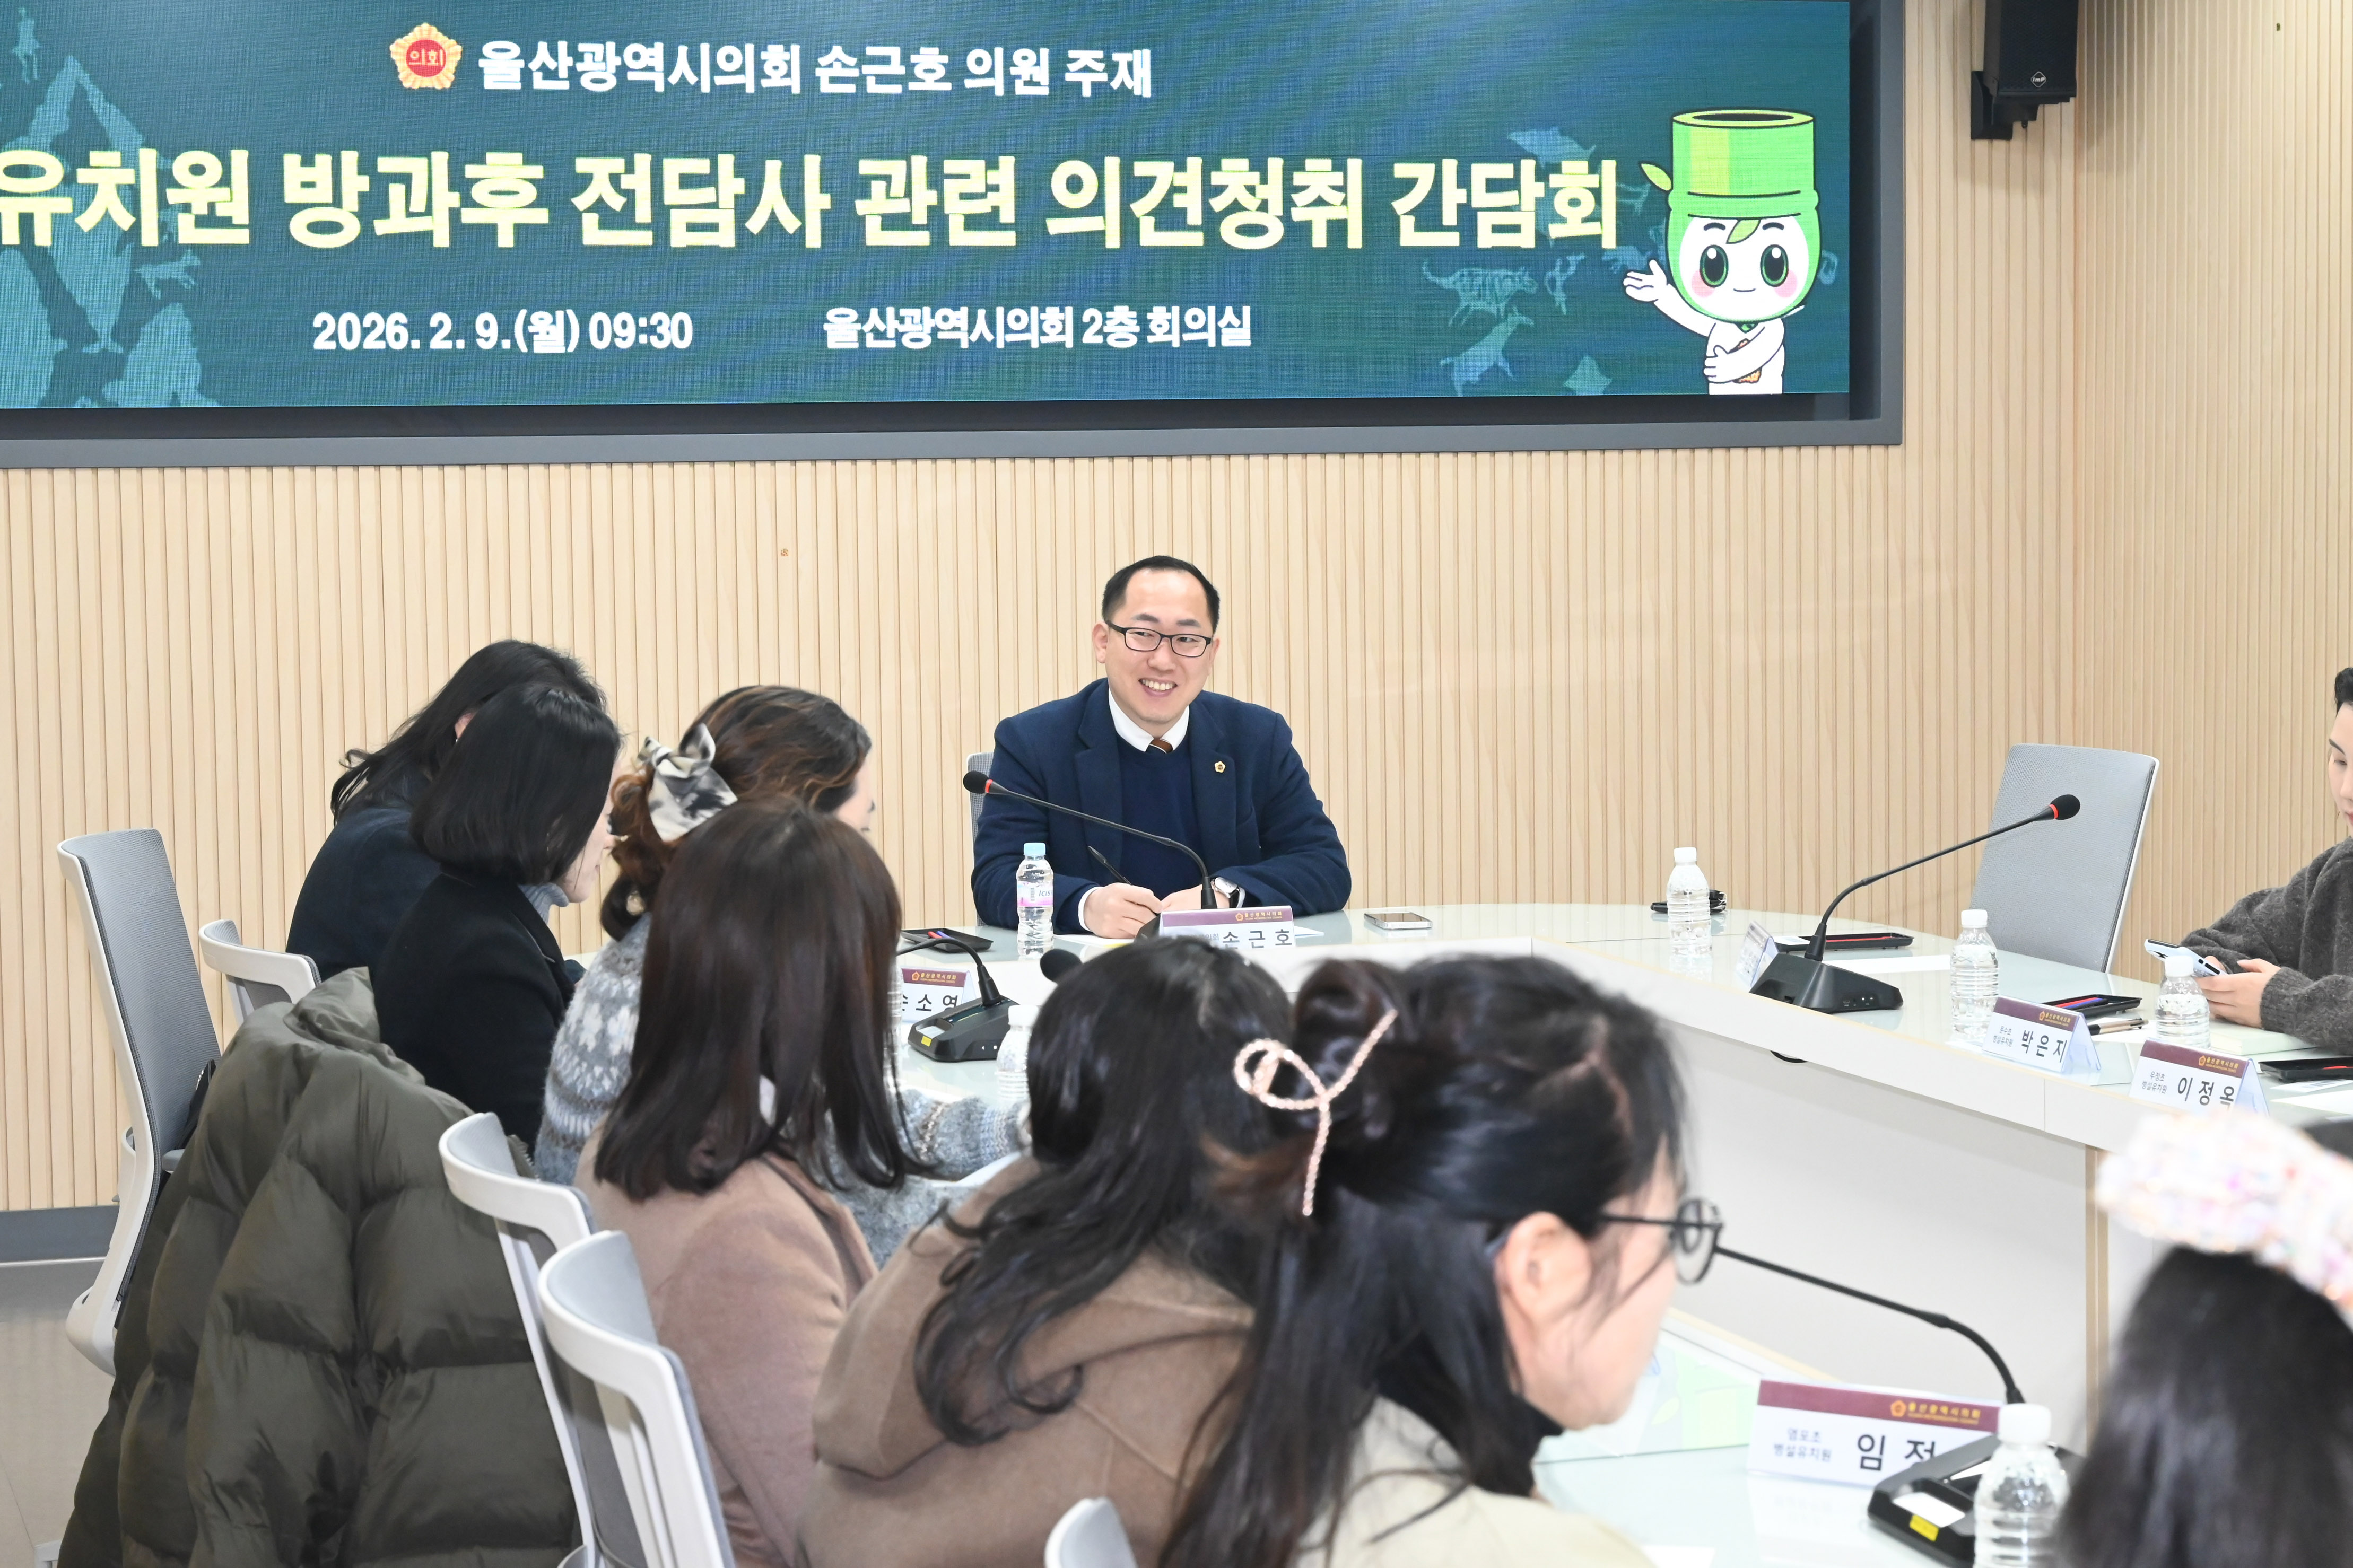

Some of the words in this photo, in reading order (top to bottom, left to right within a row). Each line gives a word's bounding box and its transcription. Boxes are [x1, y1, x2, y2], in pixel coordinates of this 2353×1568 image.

[408, 49, 444, 67] 의회
[478, 40, 801, 94] 울산광역시의회
[815, 45, 953, 94] 손근호
[963, 46, 1050, 97] 의원
[1064, 48, 1152, 98] 주재
[0, 148, 250, 247] 유치원
[283, 150, 550, 248] 방과후
[570, 153, 832, 248] 전담사
[855, 154, 1017, 247] 관련
[1045, 156, 1363, 250] 의견청취
[1391, 158, 1617, 249] 간담회
[312, 311, 421, 350] 2026.
[429, 311, 465, 349] 2.
[588, 311, 693, 350] 09:30
[823, 306, 1074, 349] 울산광역시의회
[1082, 305, 1140, 348] 2층
[1146, 305, 1252, 348] 회의실
[1222, 928, 1293, 950] 손근호
[2021, 1030, 2068, 1063] 박은지
